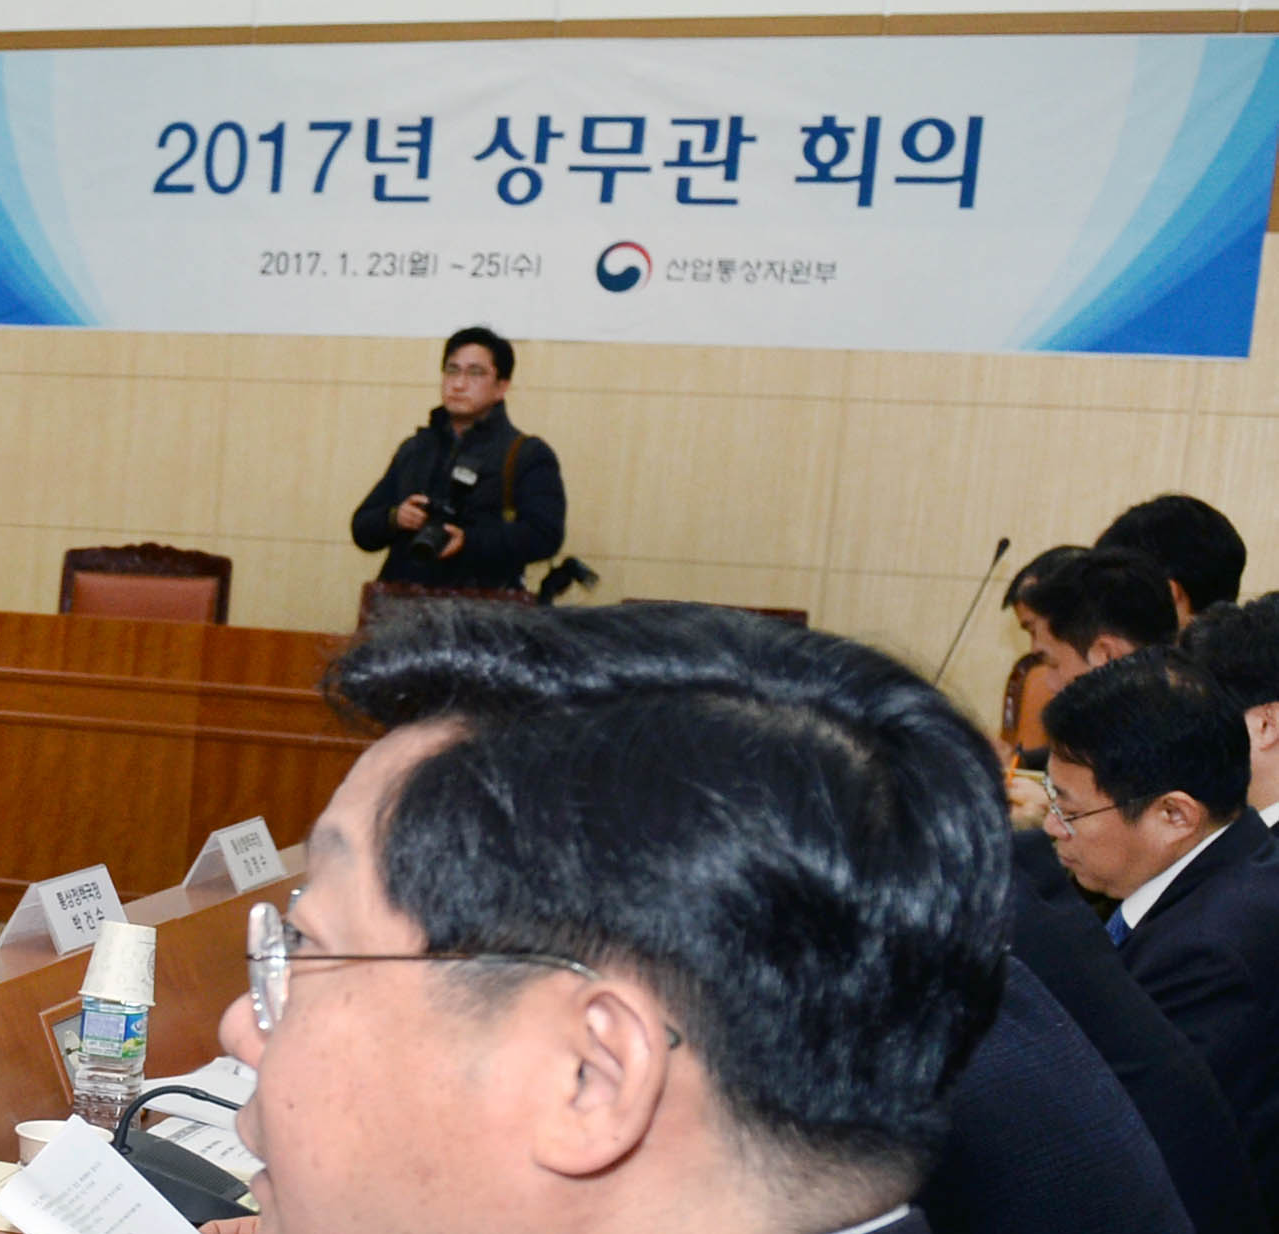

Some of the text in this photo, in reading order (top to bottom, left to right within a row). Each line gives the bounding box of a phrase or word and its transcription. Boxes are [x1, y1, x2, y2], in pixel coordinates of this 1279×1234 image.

[153, 115, 984, 209] 2017년 상무관 회의
[259, 251, 328, 277] 2017.
[666, 256, 838, 285] 산업통상자원부
